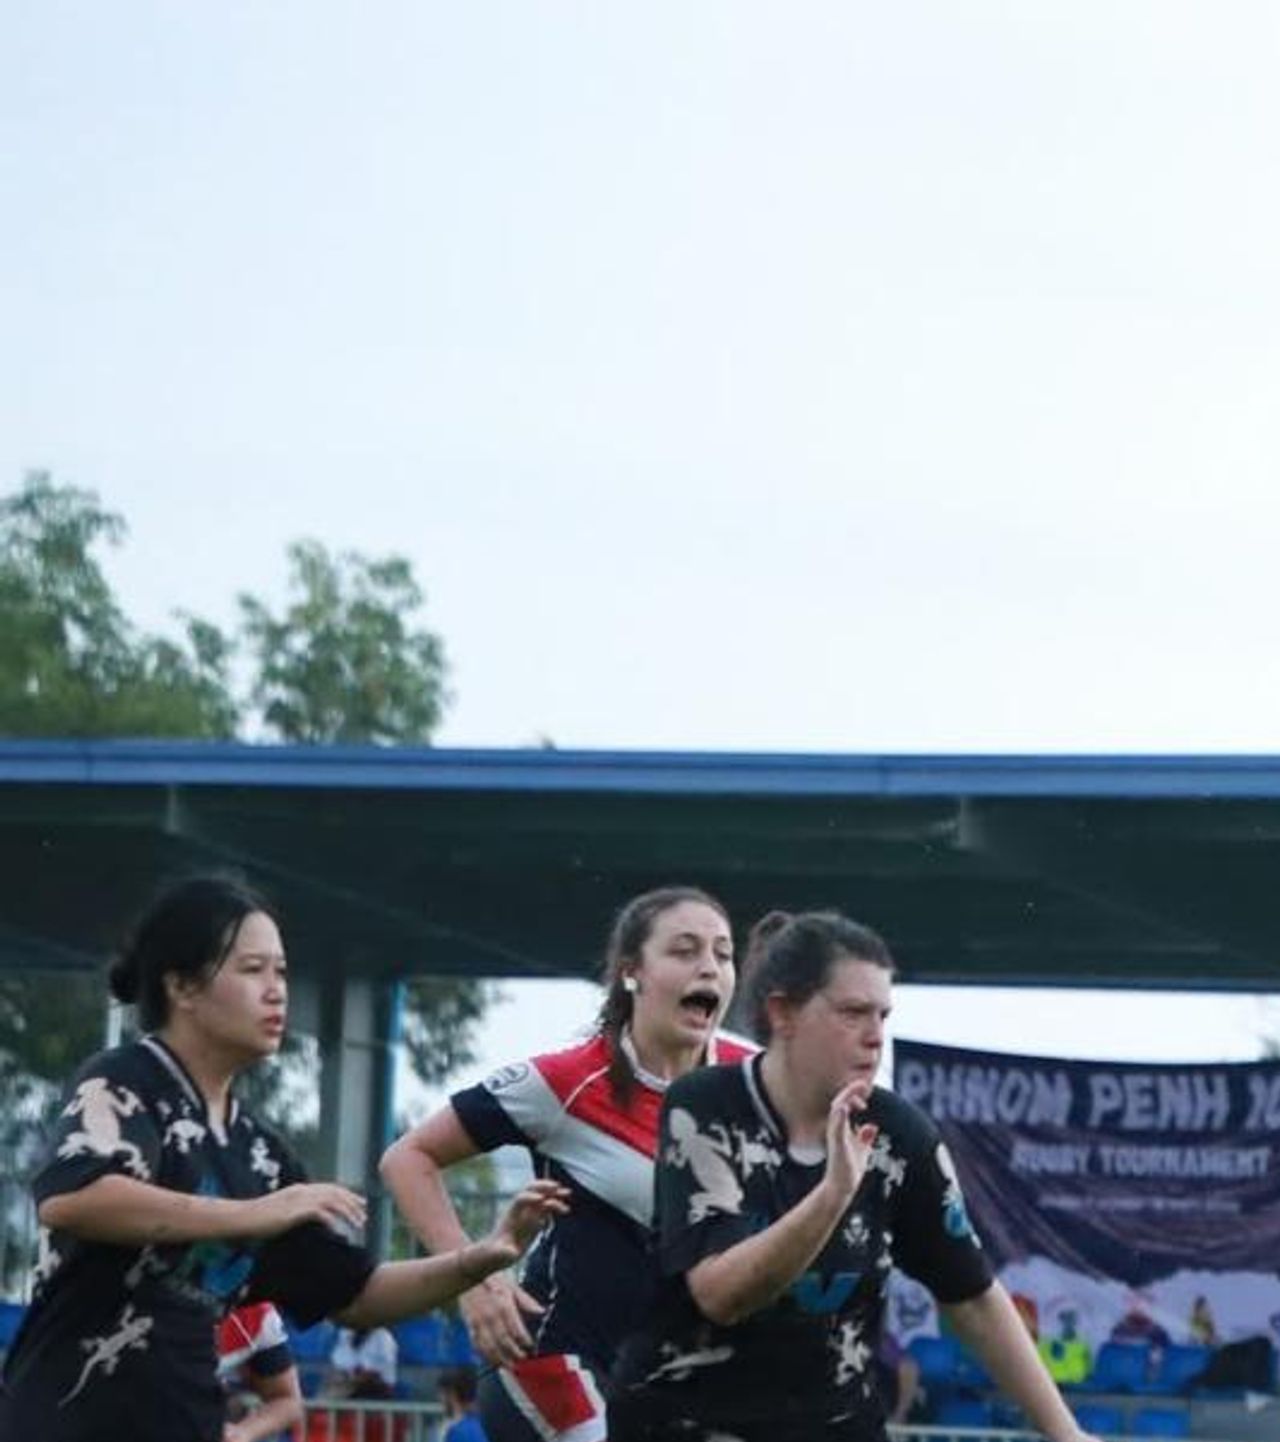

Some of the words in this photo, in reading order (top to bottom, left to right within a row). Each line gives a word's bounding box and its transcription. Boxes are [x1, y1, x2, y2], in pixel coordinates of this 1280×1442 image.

[902, 1062, 1073, 1128] PHNOM
[1087, 1072, 1231, 1131] PENH
[1100, 1145, 1270, 1178] TOURNAMENT
